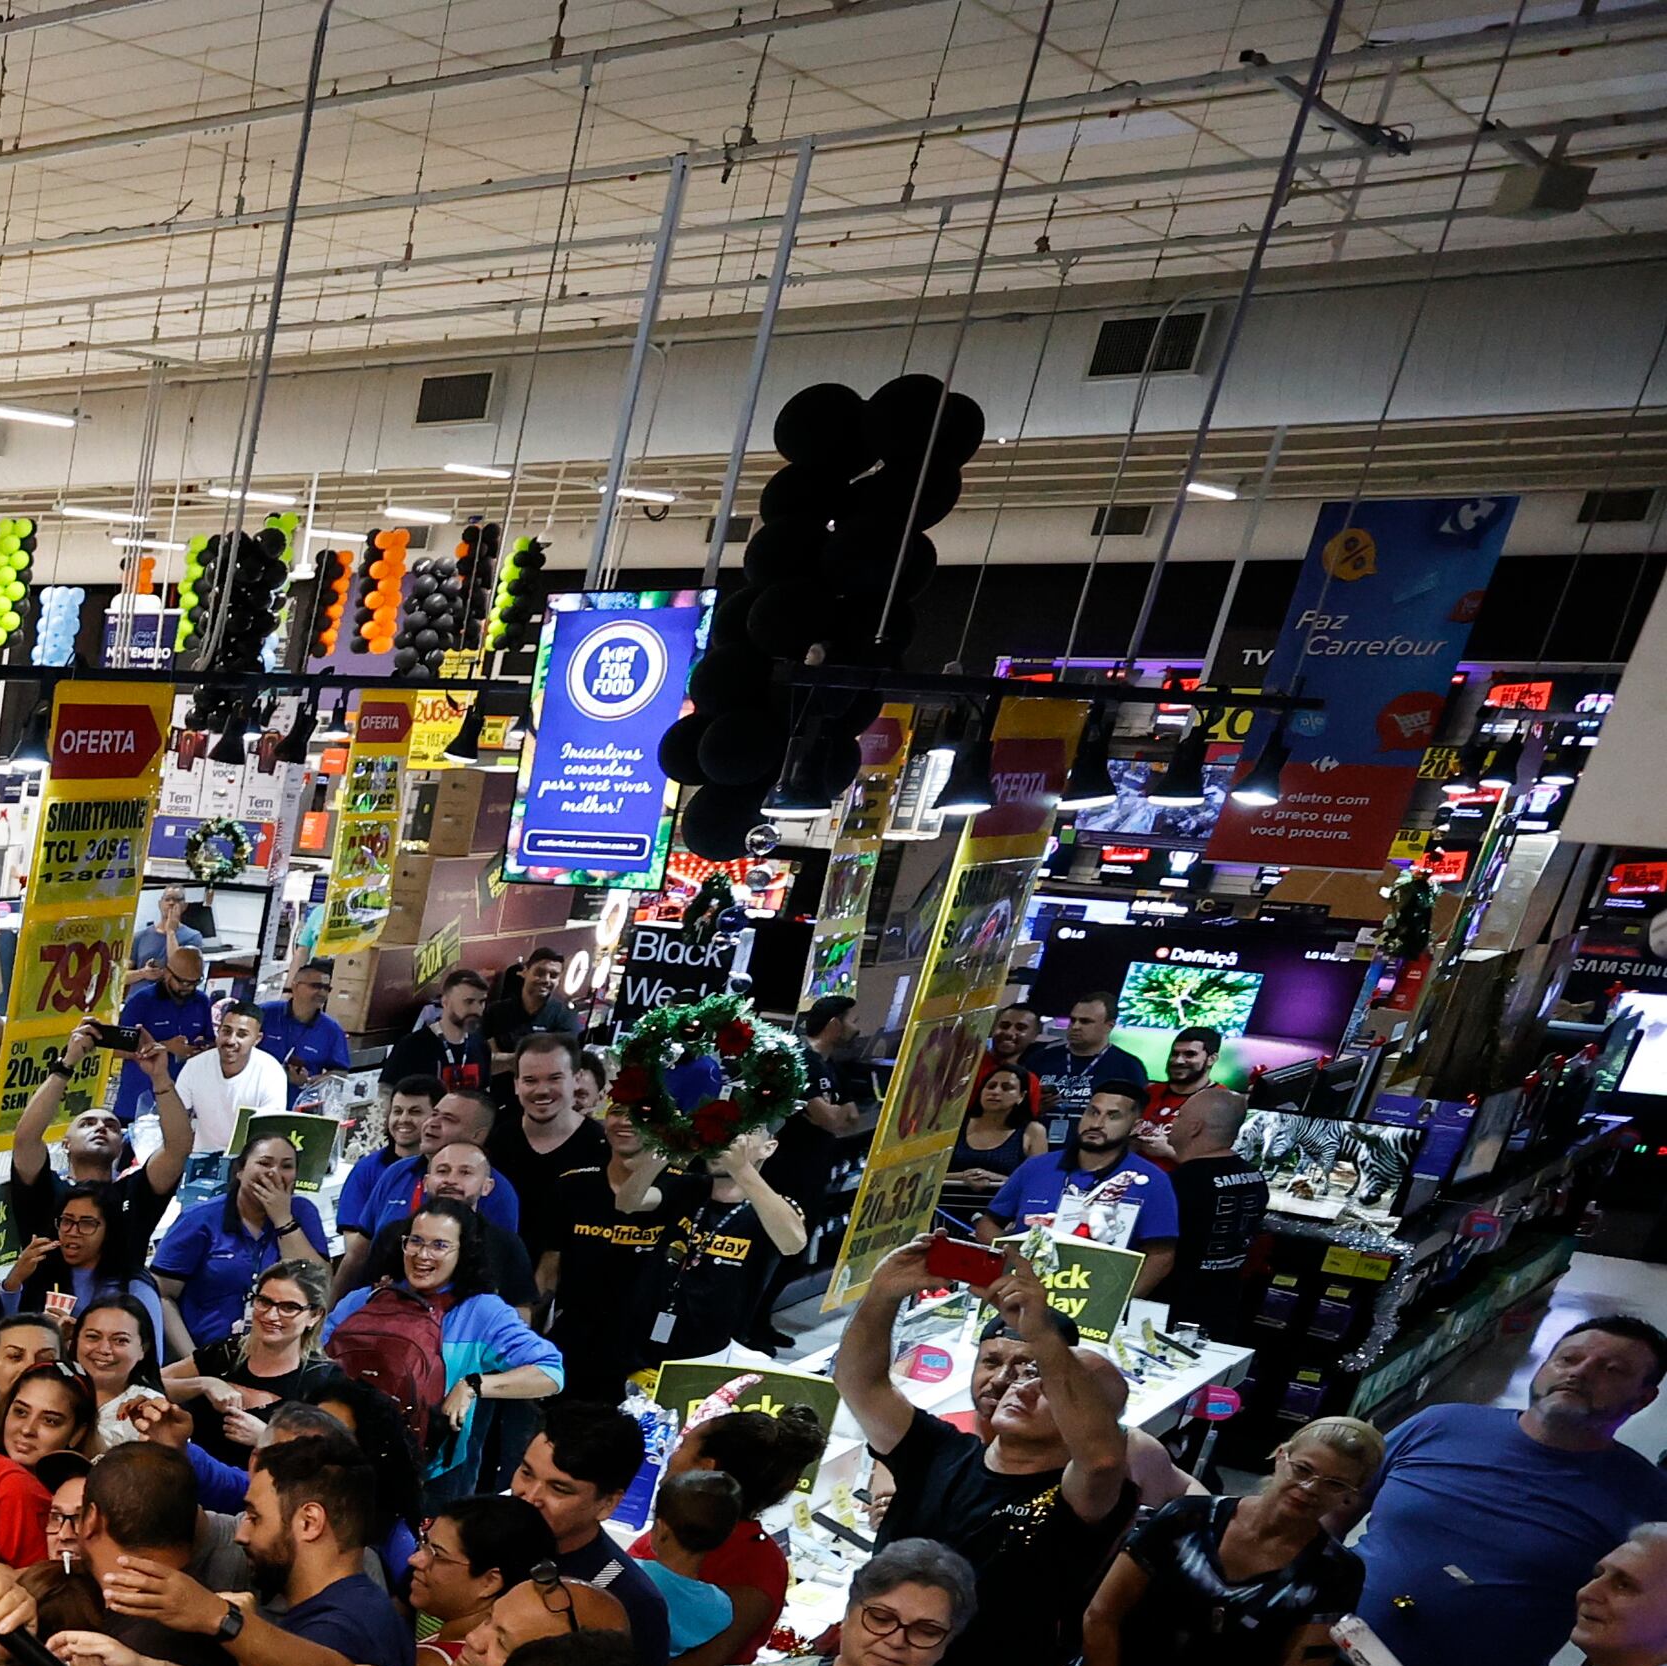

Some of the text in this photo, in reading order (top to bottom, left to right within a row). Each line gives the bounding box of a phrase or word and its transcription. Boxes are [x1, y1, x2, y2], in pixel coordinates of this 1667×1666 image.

[105, 646, 171, 660] NOVEMBRO
[1305, 634, 1449, 656] Carrefour
[1241, 650, 1276, 666] TV
[599, 663, 632, 679] FOR
[591, 678, 636, 696] FOOD
[361, 715, 400, 730] OFERTA
[59, 728, 135, 755] OFERTA
[560, 742, 644, 761] Iniciativas
[563, 762, 634, 777] concretas
[537, 777, 653, 799] para você viver
[169, 790, 193, 804] Tem
[248, 795, 274, 809] Tem
[1287, 791, 1370, 806] eletro com
[561, 798, 625, 815] melhor!
[1275, 809, 1353, 825] preço que
[1249, 825, 1352, 841] você procura.
[43, 839, 78, 866] TCL
[1071, 928, 1086, 940] LG
[631, 930, 723, 968] Black
[11, 1042, 28, 1055] OU
